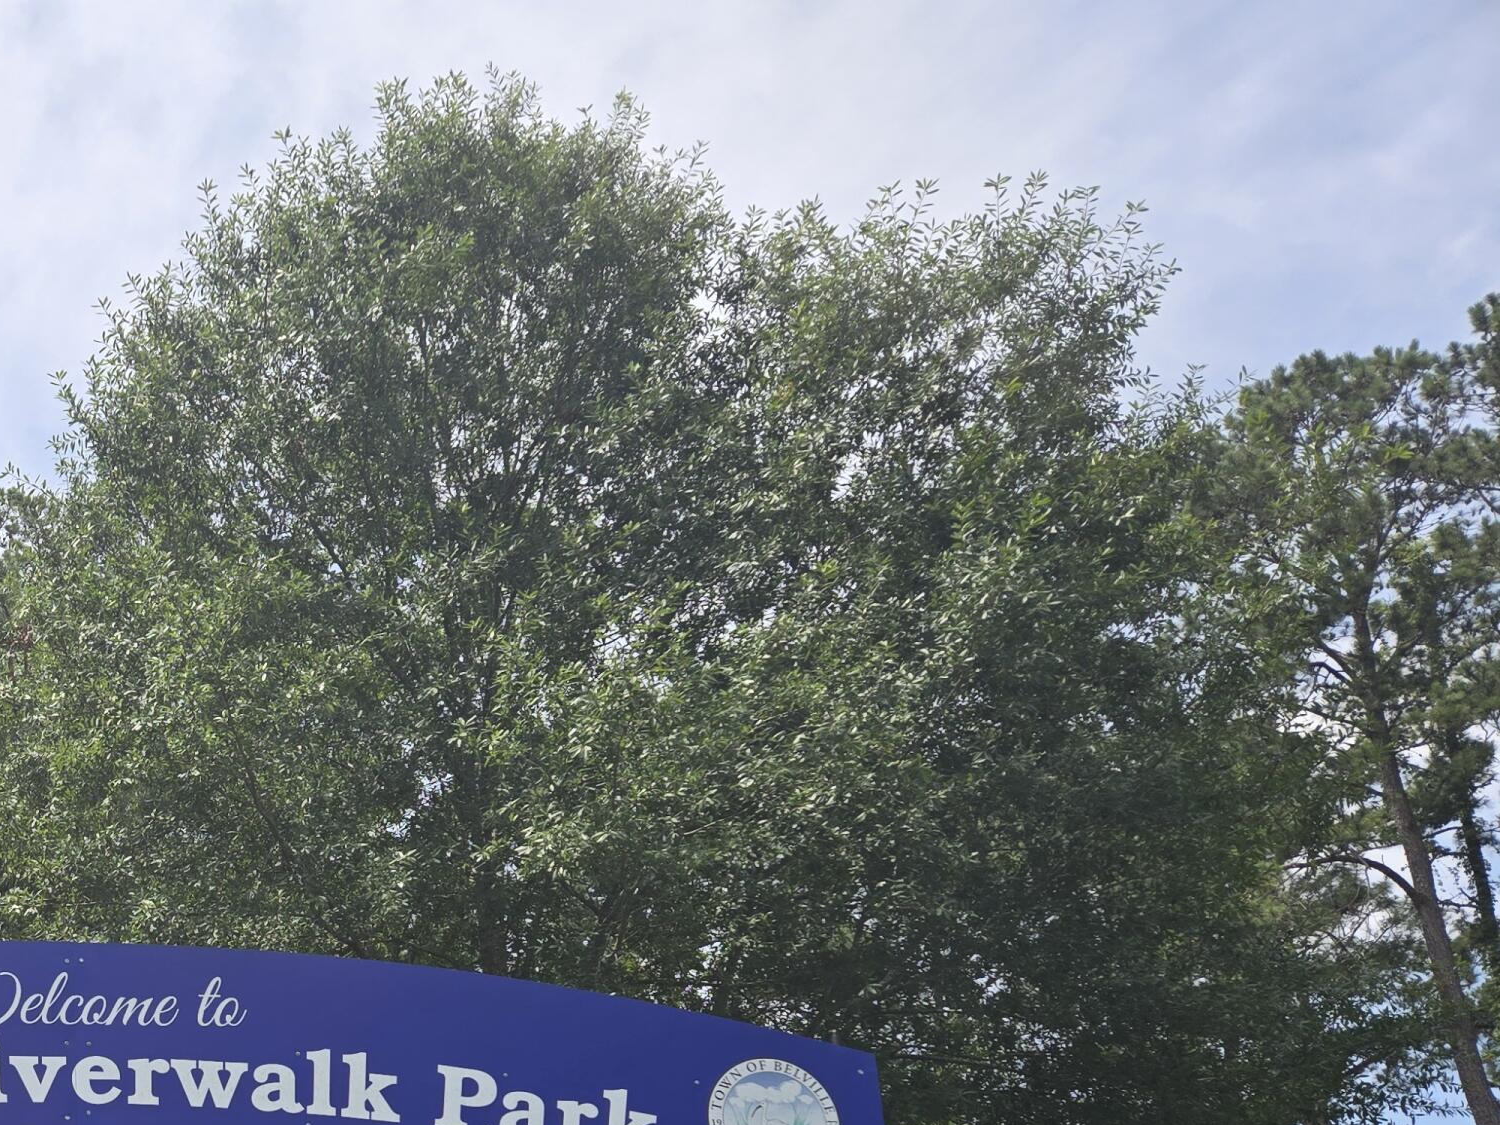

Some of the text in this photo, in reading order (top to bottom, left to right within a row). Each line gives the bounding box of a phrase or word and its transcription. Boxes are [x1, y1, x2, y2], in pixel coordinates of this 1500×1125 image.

[197, 976, 248, 1028] to
[711, 1060, 836, 1115] TOWN OF BELVILLE
